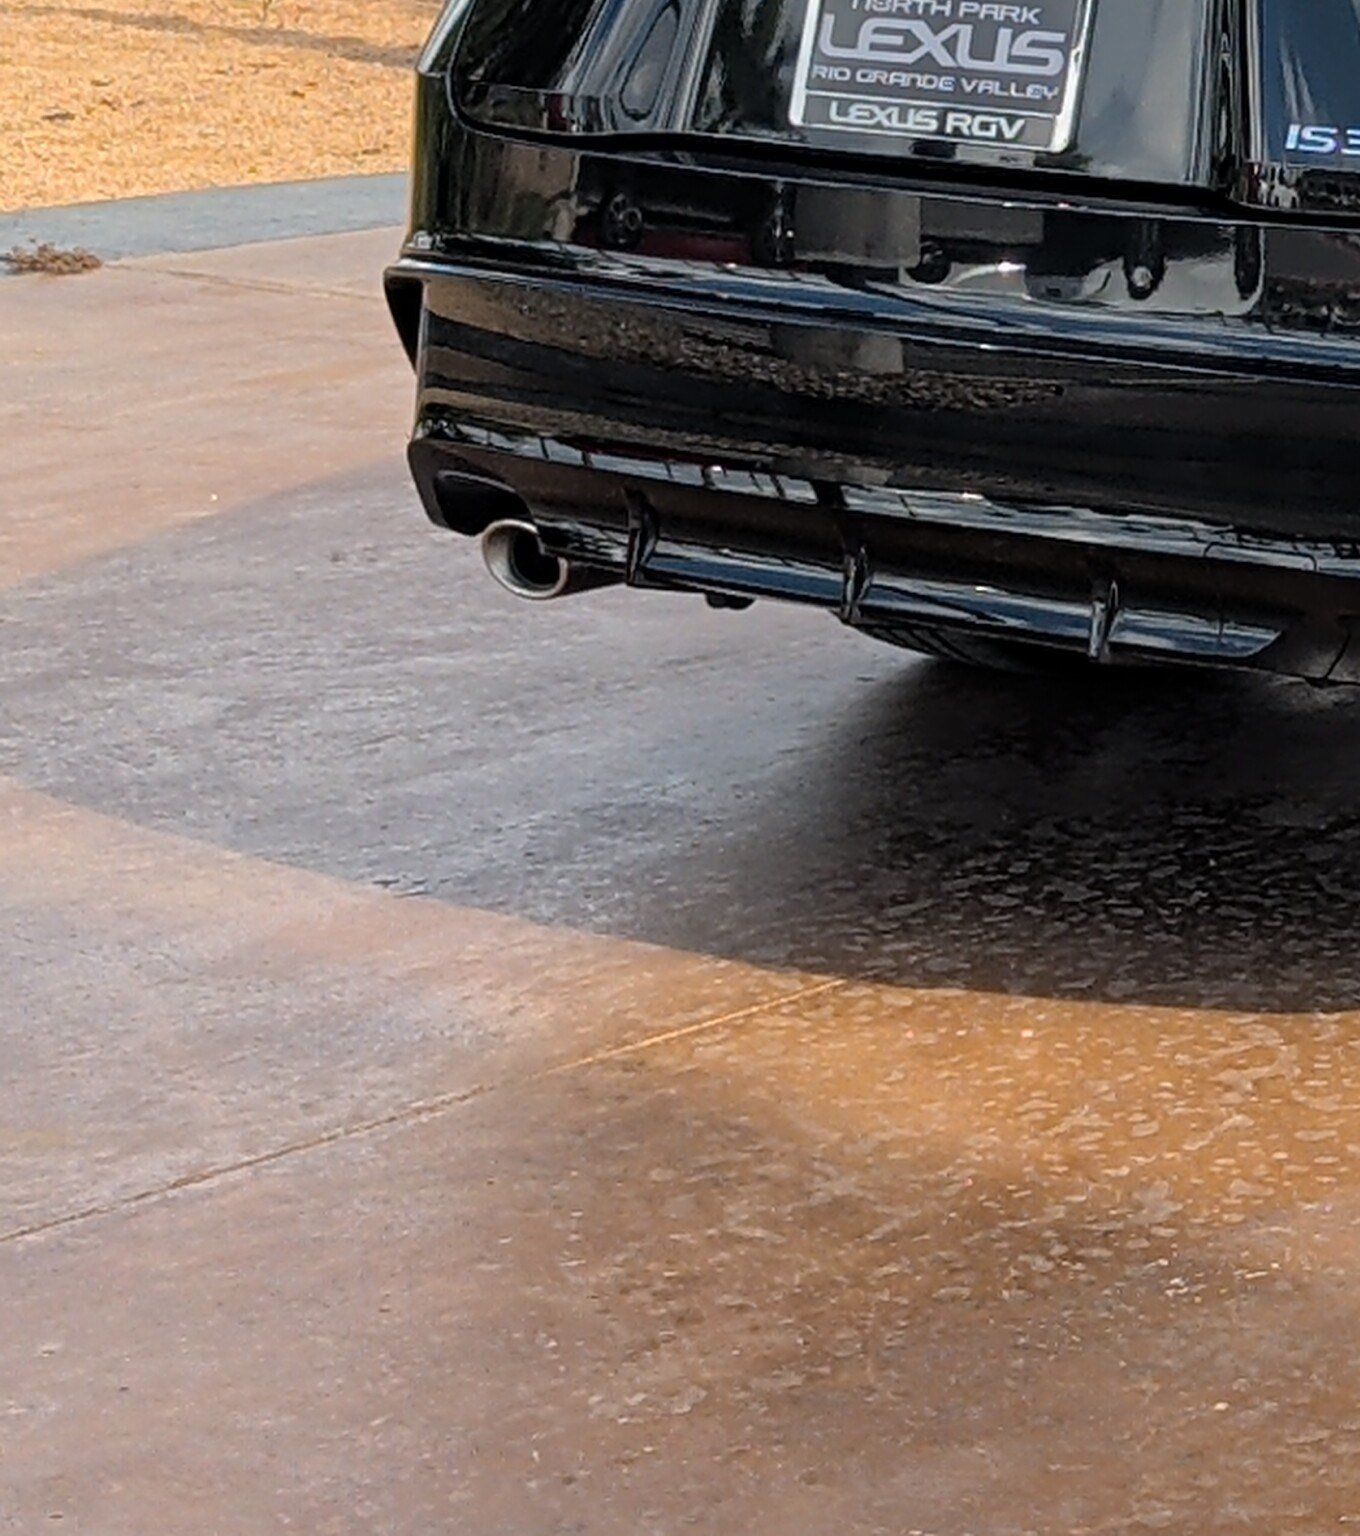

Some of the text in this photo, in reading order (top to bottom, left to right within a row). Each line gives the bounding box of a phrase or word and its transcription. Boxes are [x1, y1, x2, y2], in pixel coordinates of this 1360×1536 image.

[958, 1, 1042, 25] PARK
[818, 13, 1067, 77] LEXUS
[810, 64, 1060, 100] RIO GRANDE VALLEY
[829, 100, 1026, 140] LEXUS RGV
[1285, 123, 1338, 154] IS
